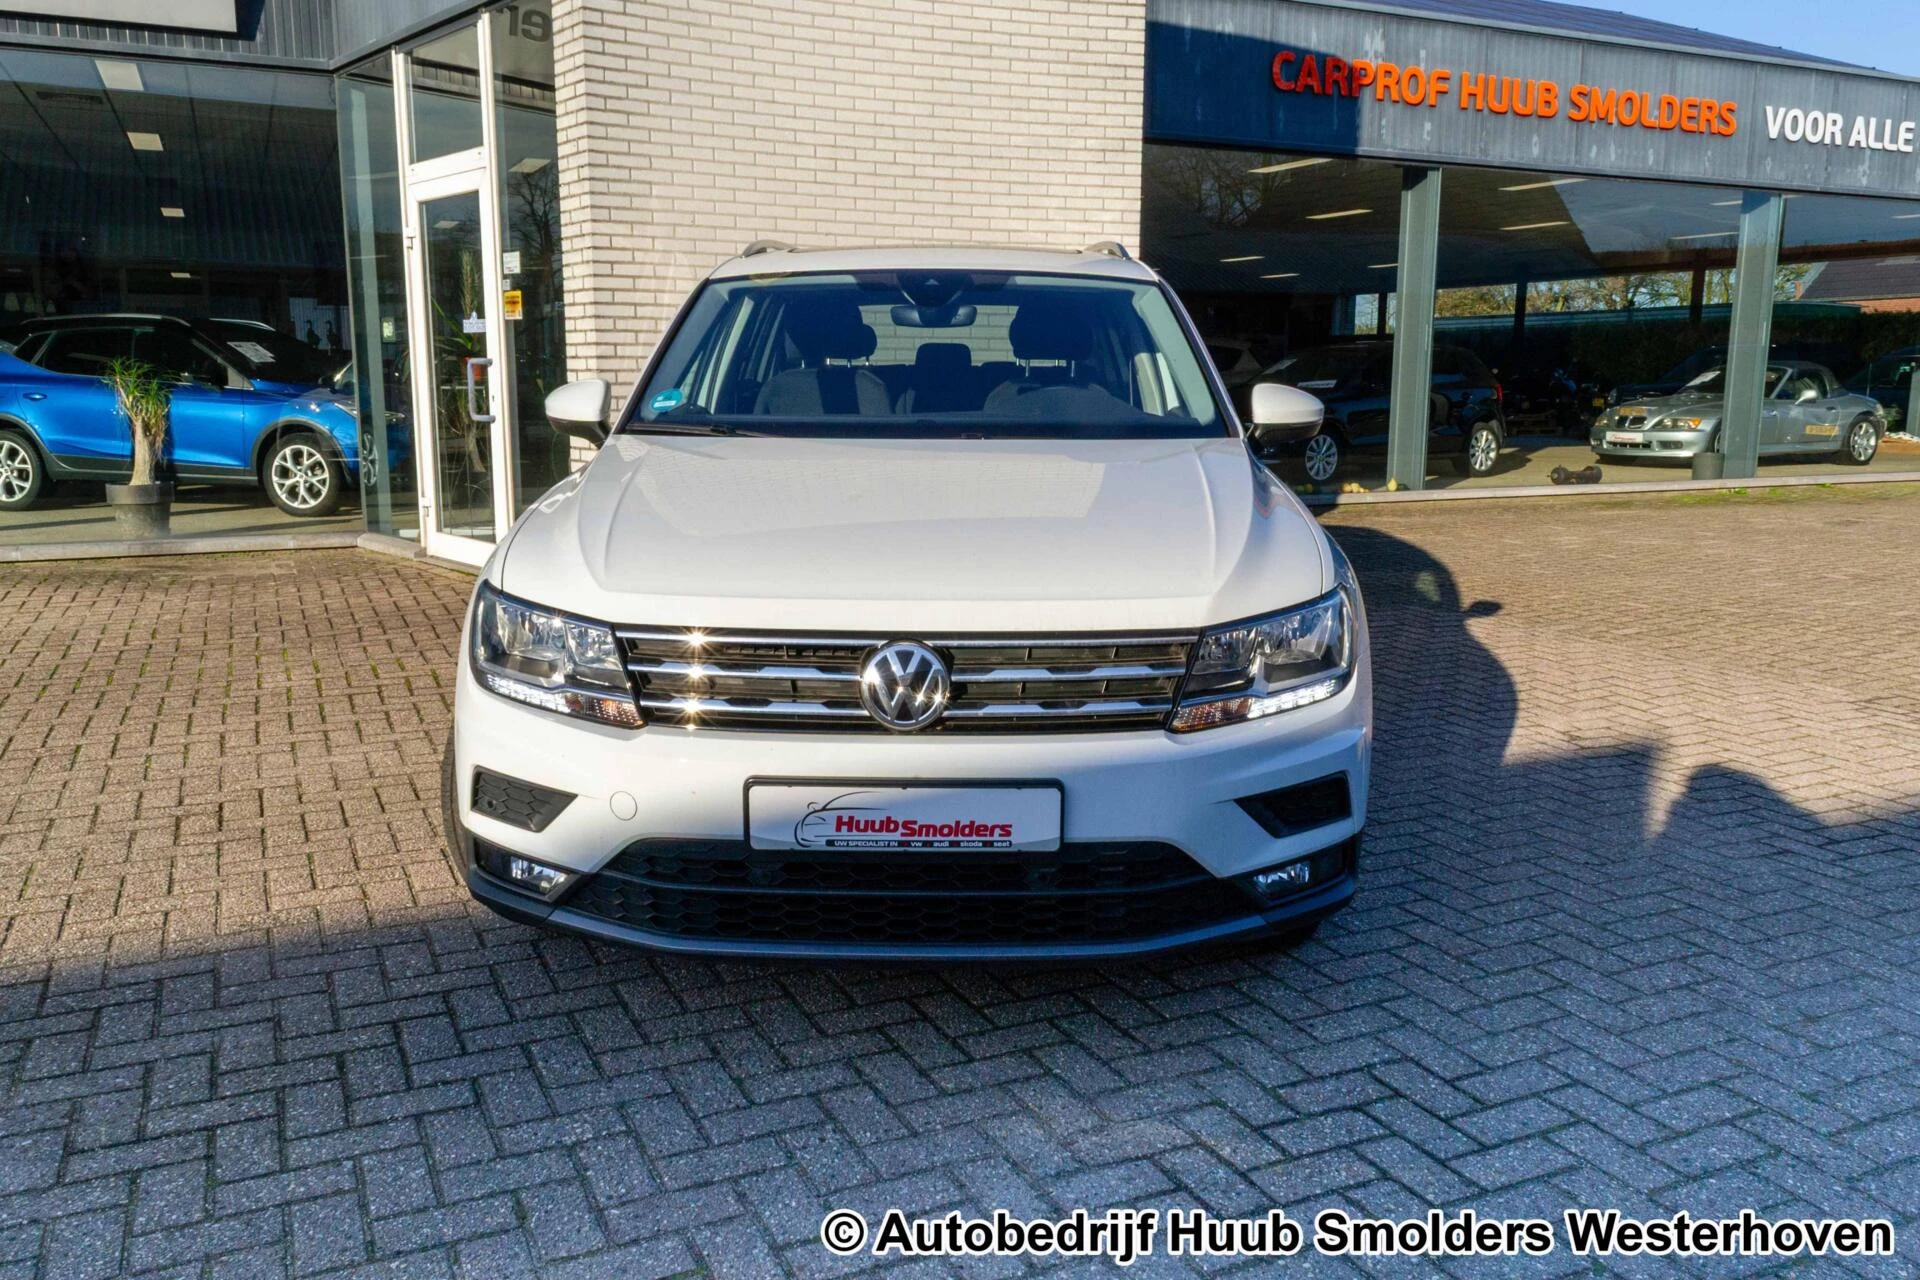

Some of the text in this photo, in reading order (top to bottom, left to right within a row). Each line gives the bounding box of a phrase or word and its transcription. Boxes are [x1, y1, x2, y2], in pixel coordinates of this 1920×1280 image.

[1272, 51, 1916, 153] CARPROF HUUB SMOLDERS VOOR ALLE
